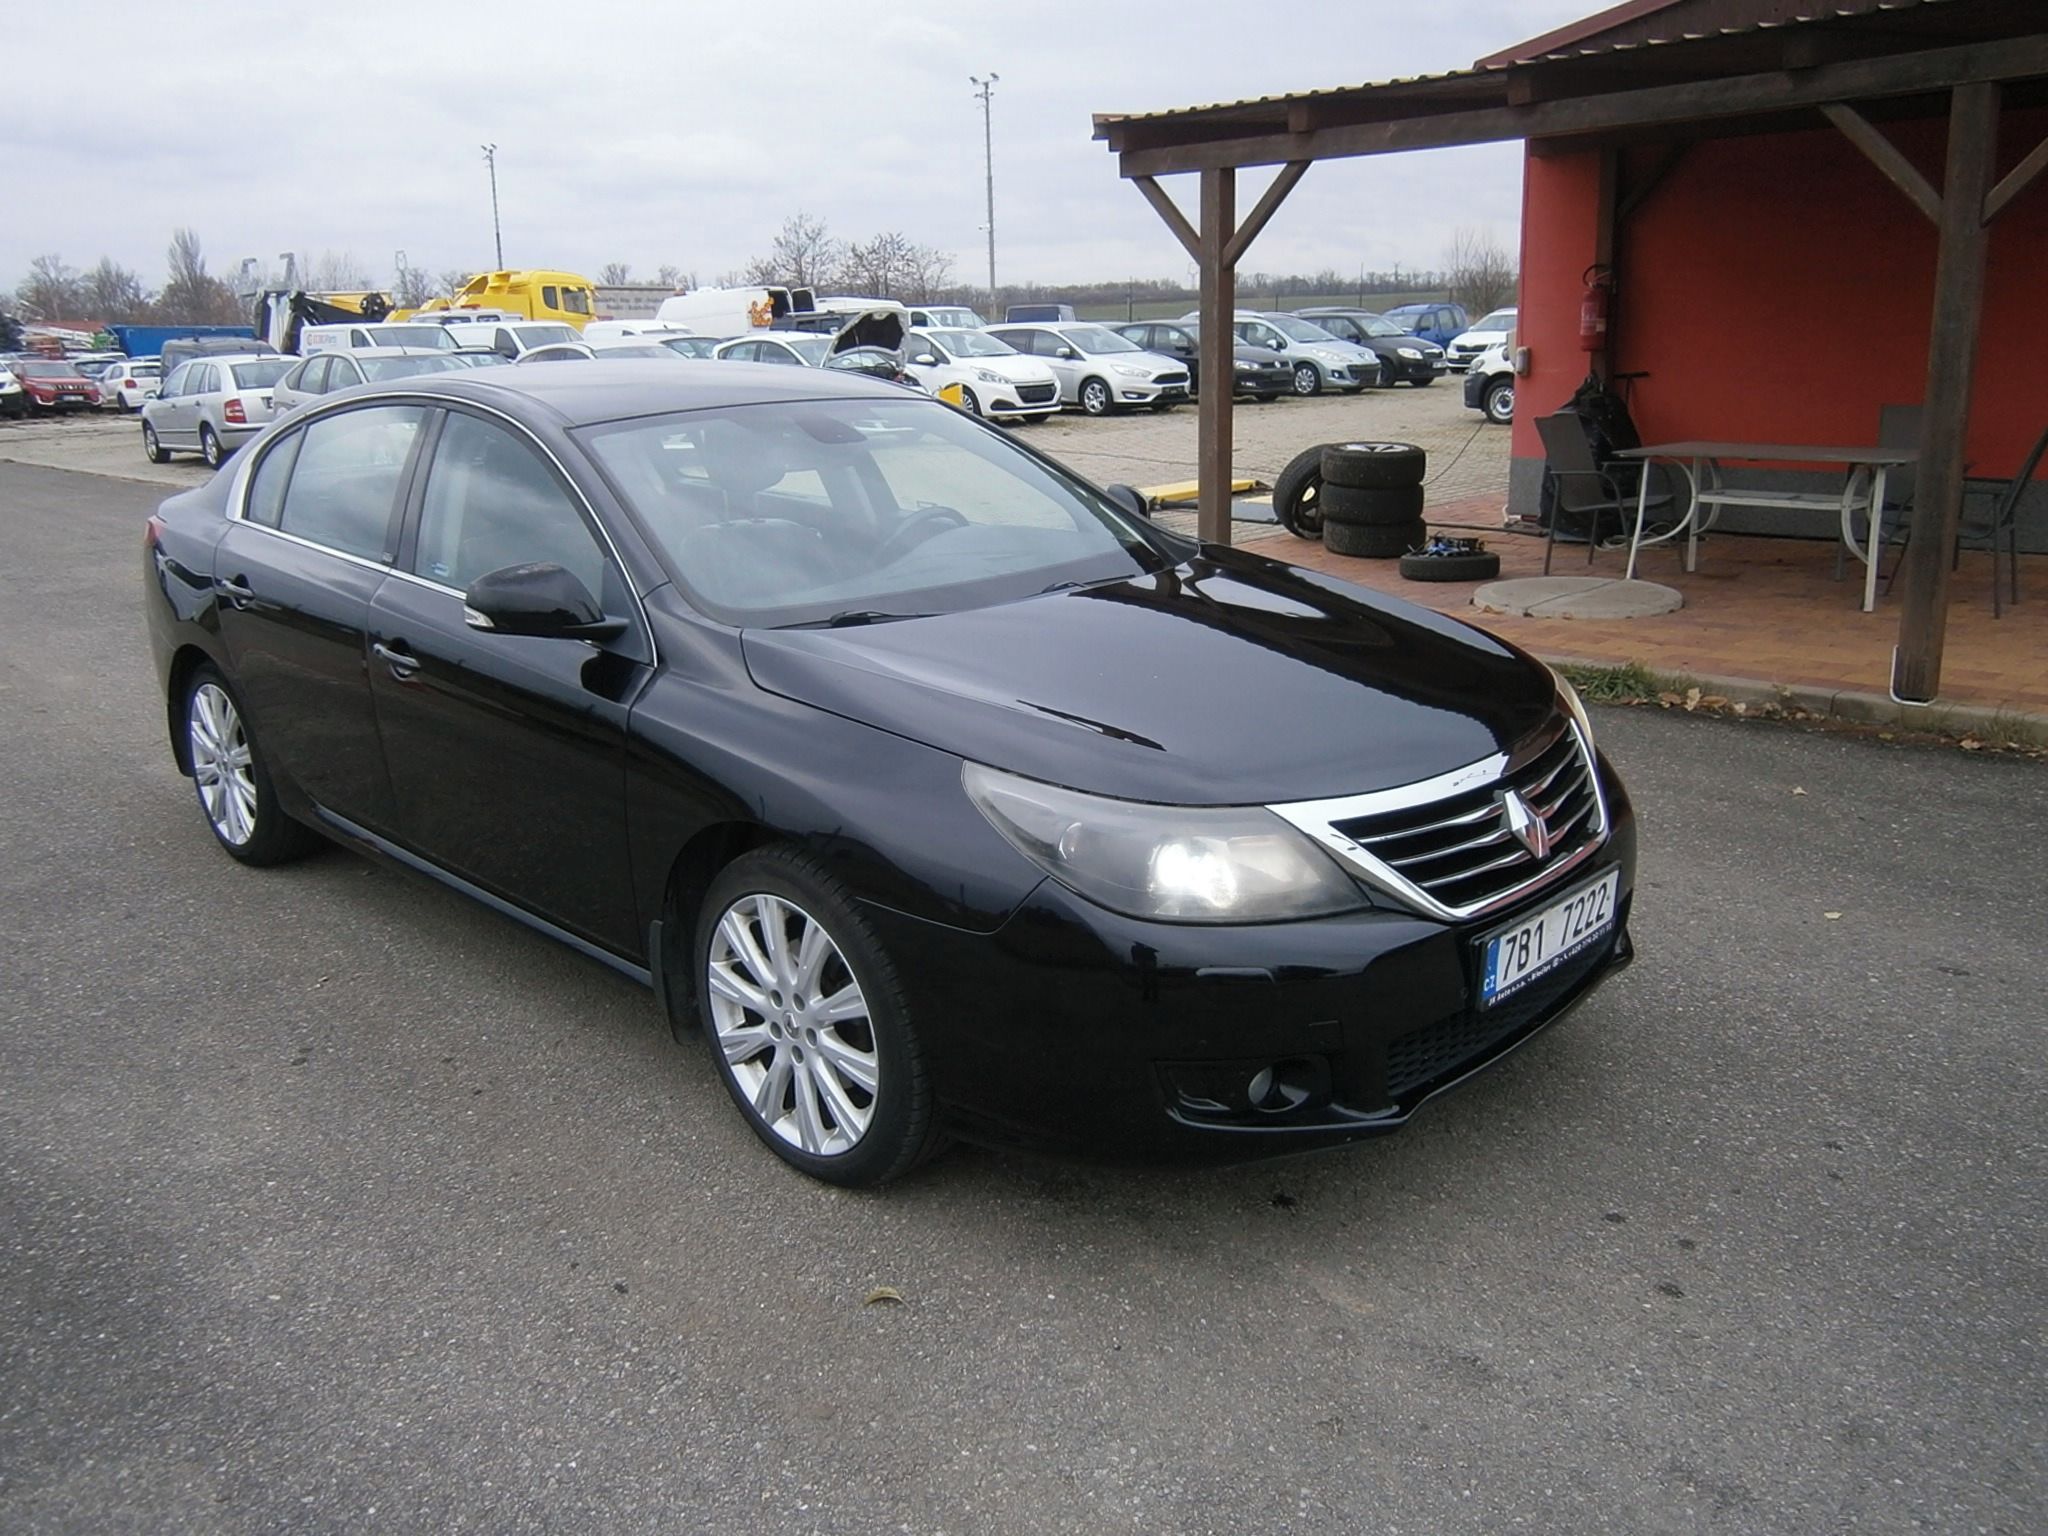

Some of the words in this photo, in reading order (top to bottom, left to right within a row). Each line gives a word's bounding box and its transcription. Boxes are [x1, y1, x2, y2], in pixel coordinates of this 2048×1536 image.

[1502, 919, 1545, 981] 7B1
[1561, 882, 1608, 946] 7222
[1483, 975, 1495, 992] CZ
